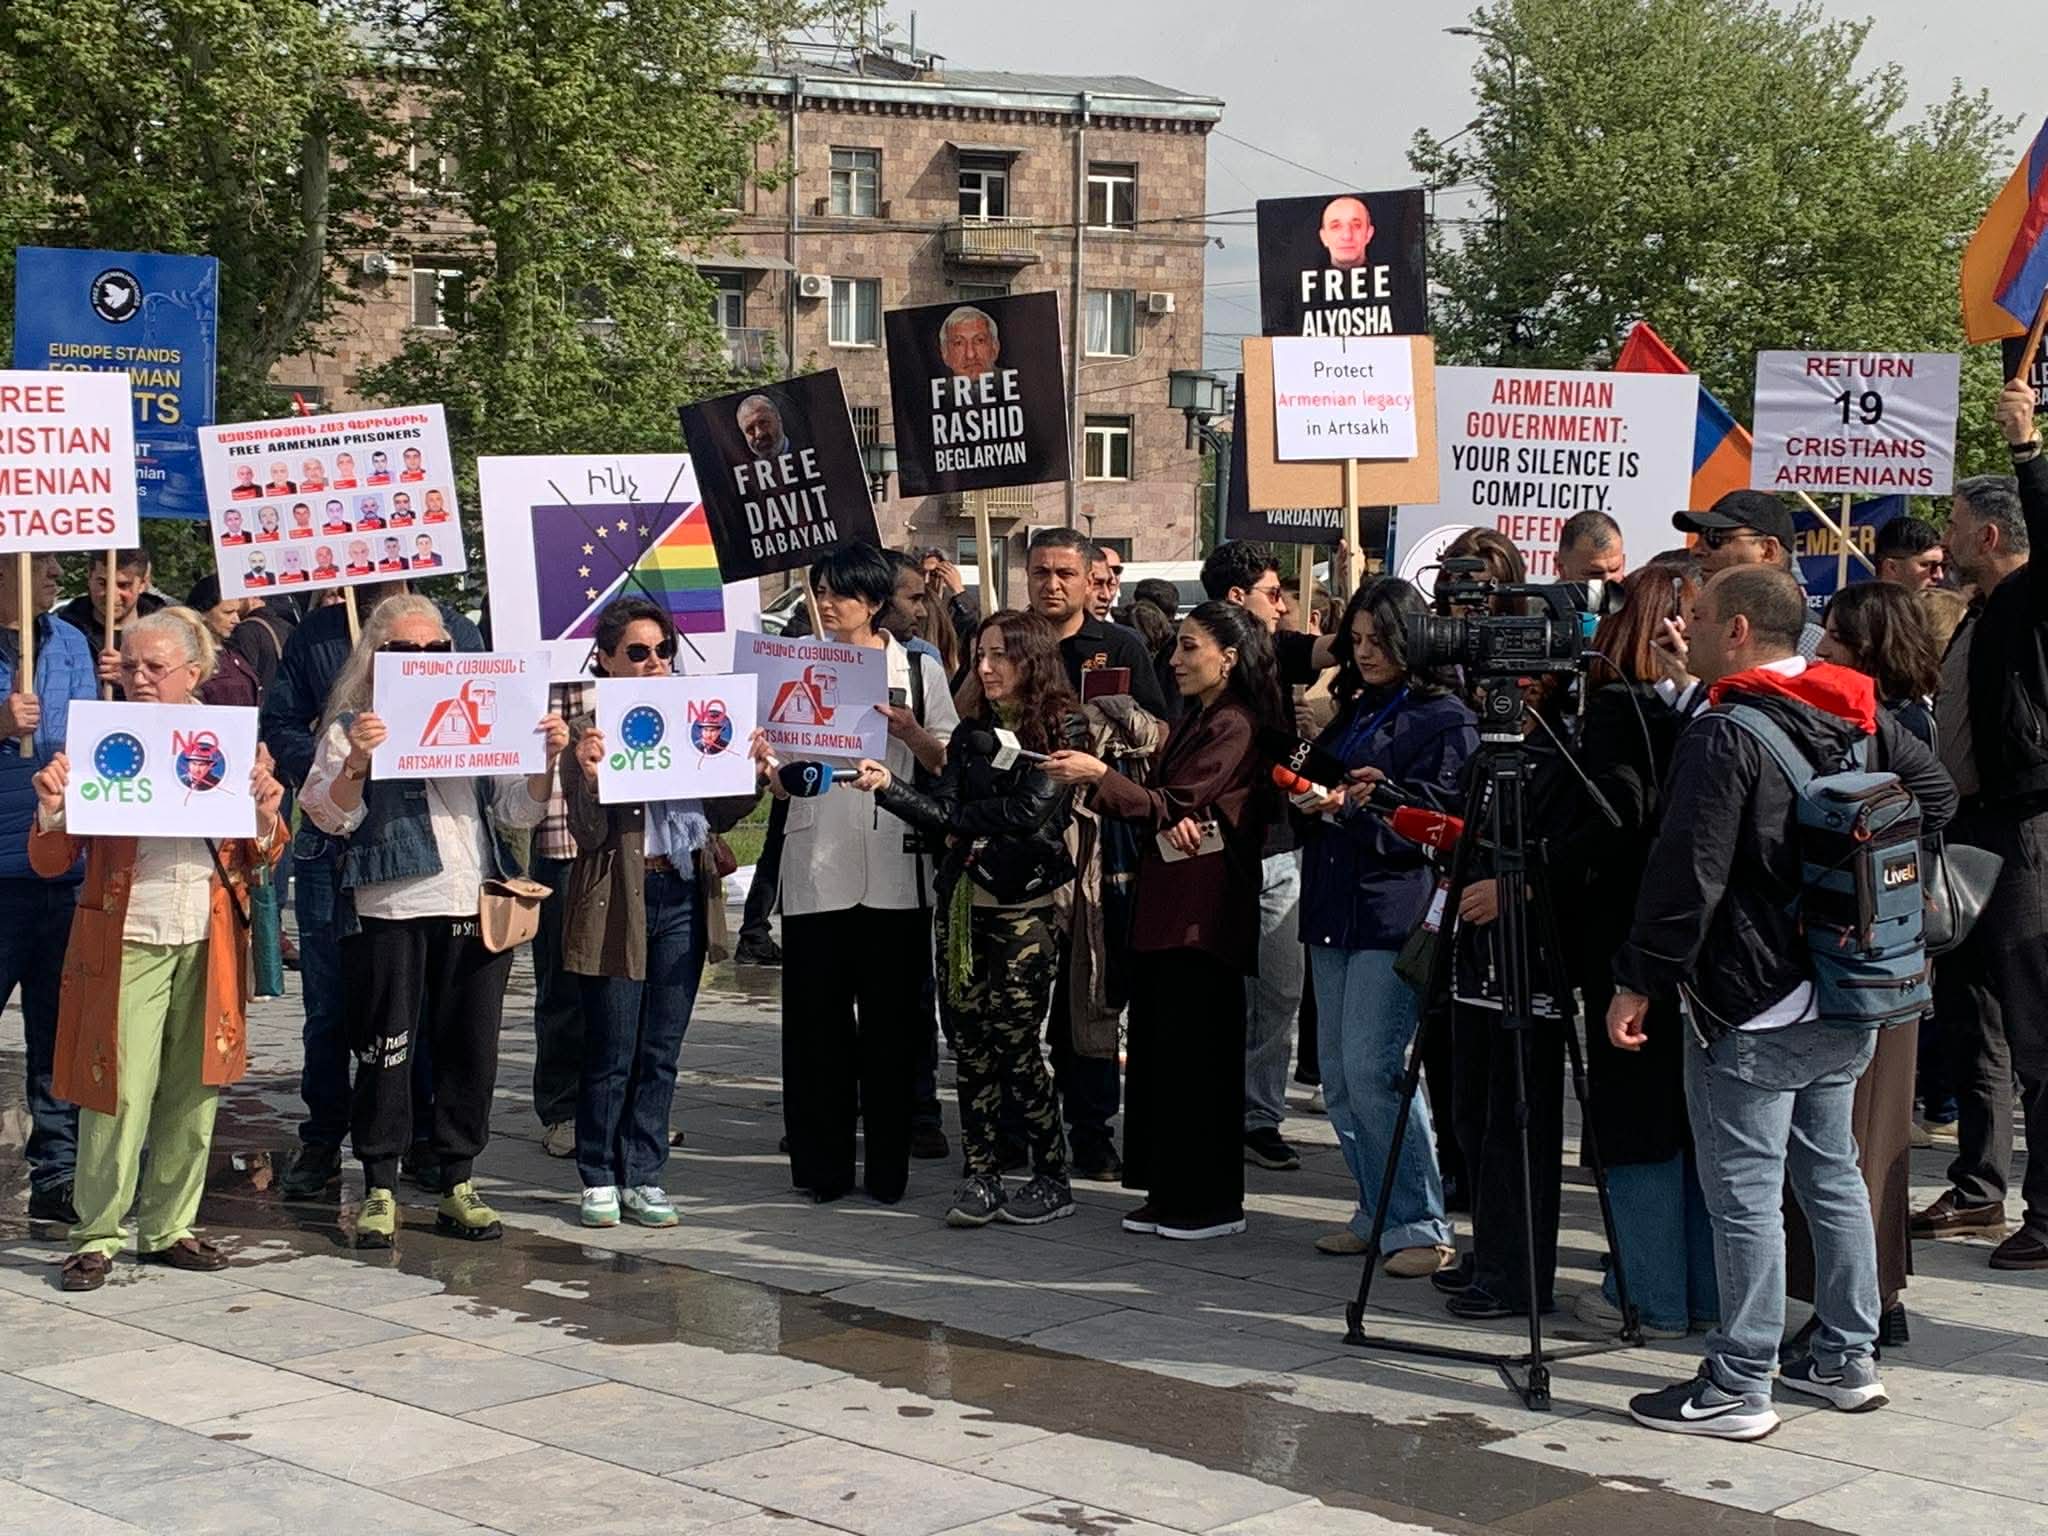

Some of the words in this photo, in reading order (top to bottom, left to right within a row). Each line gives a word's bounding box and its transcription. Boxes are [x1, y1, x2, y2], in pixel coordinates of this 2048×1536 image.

[1302, 265, 1391, 303] FREE
[1303, 305, 1393, 337] ALYOSHA
[49, 343, 112, 360] EUROPE
[116, 347, 181, 364] STANDS
[1806, 357, 1913, 378] RETURN
[1314, 361, 1374, 378] Protect
[0, 386, 65, 413] REE
[931, 369, 1021, 409] FREE
[1278, 392, 1357, 407] Armenian
[1363, 392, 1412, 411] legacy
[1492, 378, 1613, 408] ARMENIAN
[1834, 390, 1883, 426] 19
[932, 405, 1024, 445] RASHID
[1307, 420, 1322, 435] in
[1328, 419, 1389, 435] Artsakh
[1467, 412, 1628, 443] GOVERNMENT:
[229, 444, 261, 457] FREE
[267, 437, 340, 453] ARMENIAN
[344, 428, 421, 446] PRISONERS
[935, 441, 1027, 472] BEGLARYAN
[1786, 437, 1926, 459] CRISTIANS
[136, 466, 166, 481] nian
[733, 447, 822, 496] FREE
[1452, 445, 1511, 472] YOUR
[1517, 448, 1611, 476] SILENCE
[1618, 451, 1640, 478] IS
[1775, 465, 1934, 487] ARMENIANS
[745, 484, 830, 535] DAVIT
[1472, 480, 1613, 511] COMPLICITY.
[750, 519, 839, 561] BABAYAN
[1497, 515, 1567, 543] DEFEN
[1792, 524, 1876, 557] EMBER
[687, 699, 726, 723] NO
[172, 729, 220, 756] NO
[765, 729, 799, 745] TSAKH
[801, 733, 812, 746] IS
[814, 734, 863, 751] ARMENIA
[398, 755, 452, 770] ARTSAKH
[455, 754, 466, 769] IS
[469, 752, 520, 768] ARMENIA
[625, 745, 671, 771] YES
[96, 775, 153, 803] YES
